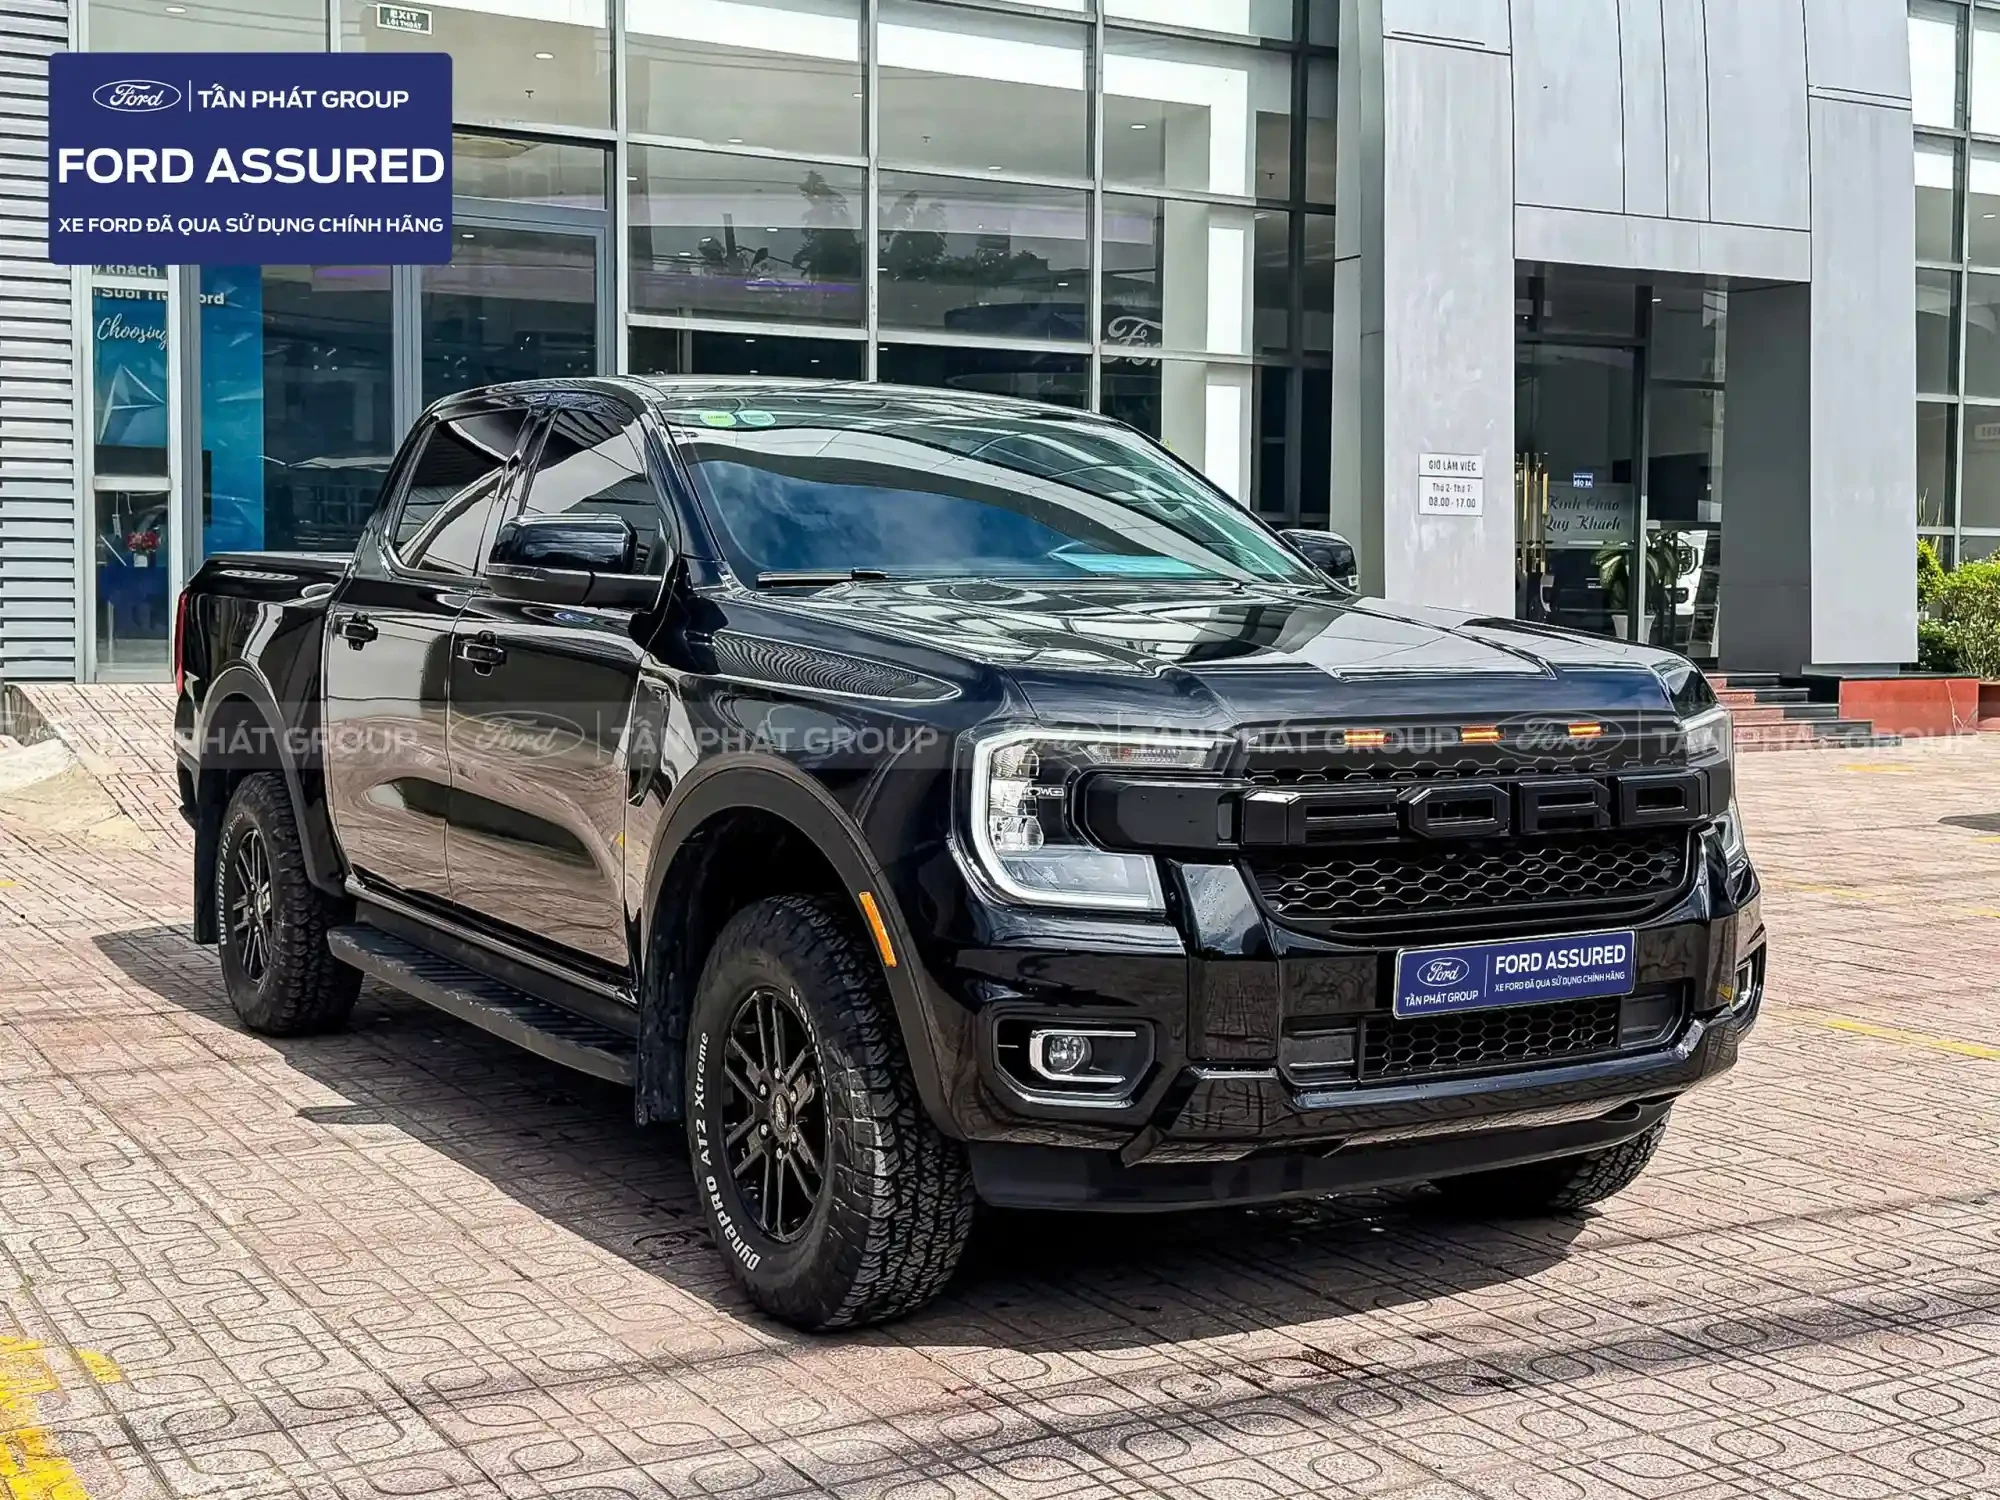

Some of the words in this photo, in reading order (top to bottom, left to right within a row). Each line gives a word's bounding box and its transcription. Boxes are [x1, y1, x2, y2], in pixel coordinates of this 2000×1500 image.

[390, 9, 418, 21] EXIT
[1242, 771, 1709, 848] FORD
[1426, 961, 1460, 982] Ford
[1495, 952, 1542, 975] FORD
[1545, 944, 1626, 971] ASSURED
[1494, 983, 1504, 993] XE
[1504, 982, 1524, 992] FORD
[1524, 978, 1535, 989] ĐÃ
[1535, 979, 1551, 990] QUA
[1562, 975, 1582, 987] DỤNG
[1582, 972, 1605, 983] CHÍNH
[1605, 970, 1625, 981] HÃNG
[1423, 991, 1447, 1005] PHÁT
[1447, 990, 1479, 1003] GROUP
[694, 1032, 709, 1110] Xtreme
[695, 1118, 712, 1166] AT2
